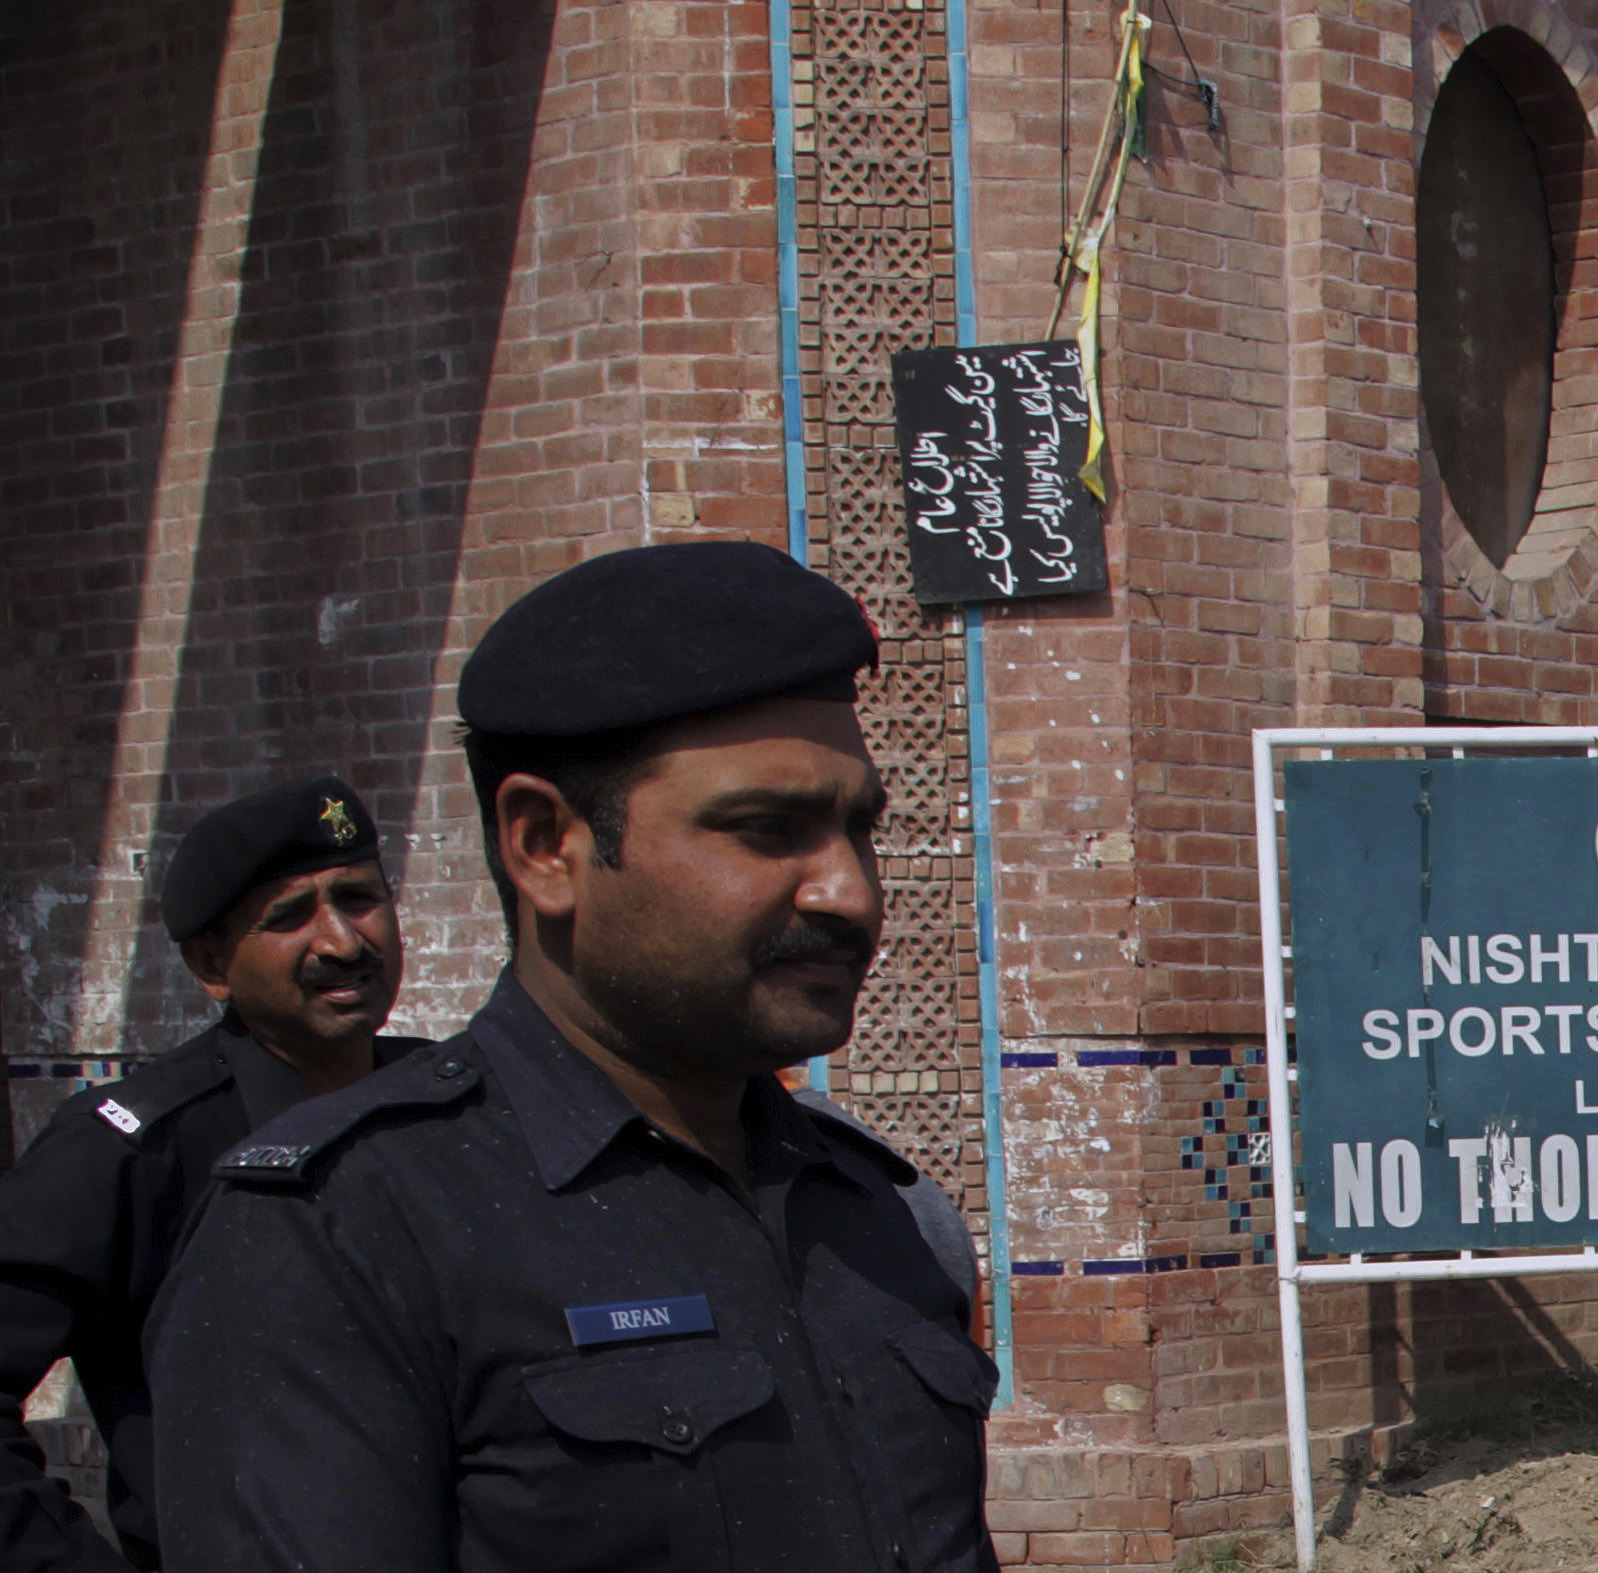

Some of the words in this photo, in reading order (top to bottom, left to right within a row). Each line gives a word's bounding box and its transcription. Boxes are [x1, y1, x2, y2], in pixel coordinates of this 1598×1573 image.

[915, 496, 960, 534] عام
[1333, 1139, 1423, 1228] NO
[609, 1306, 671, 1331] IRFAN
